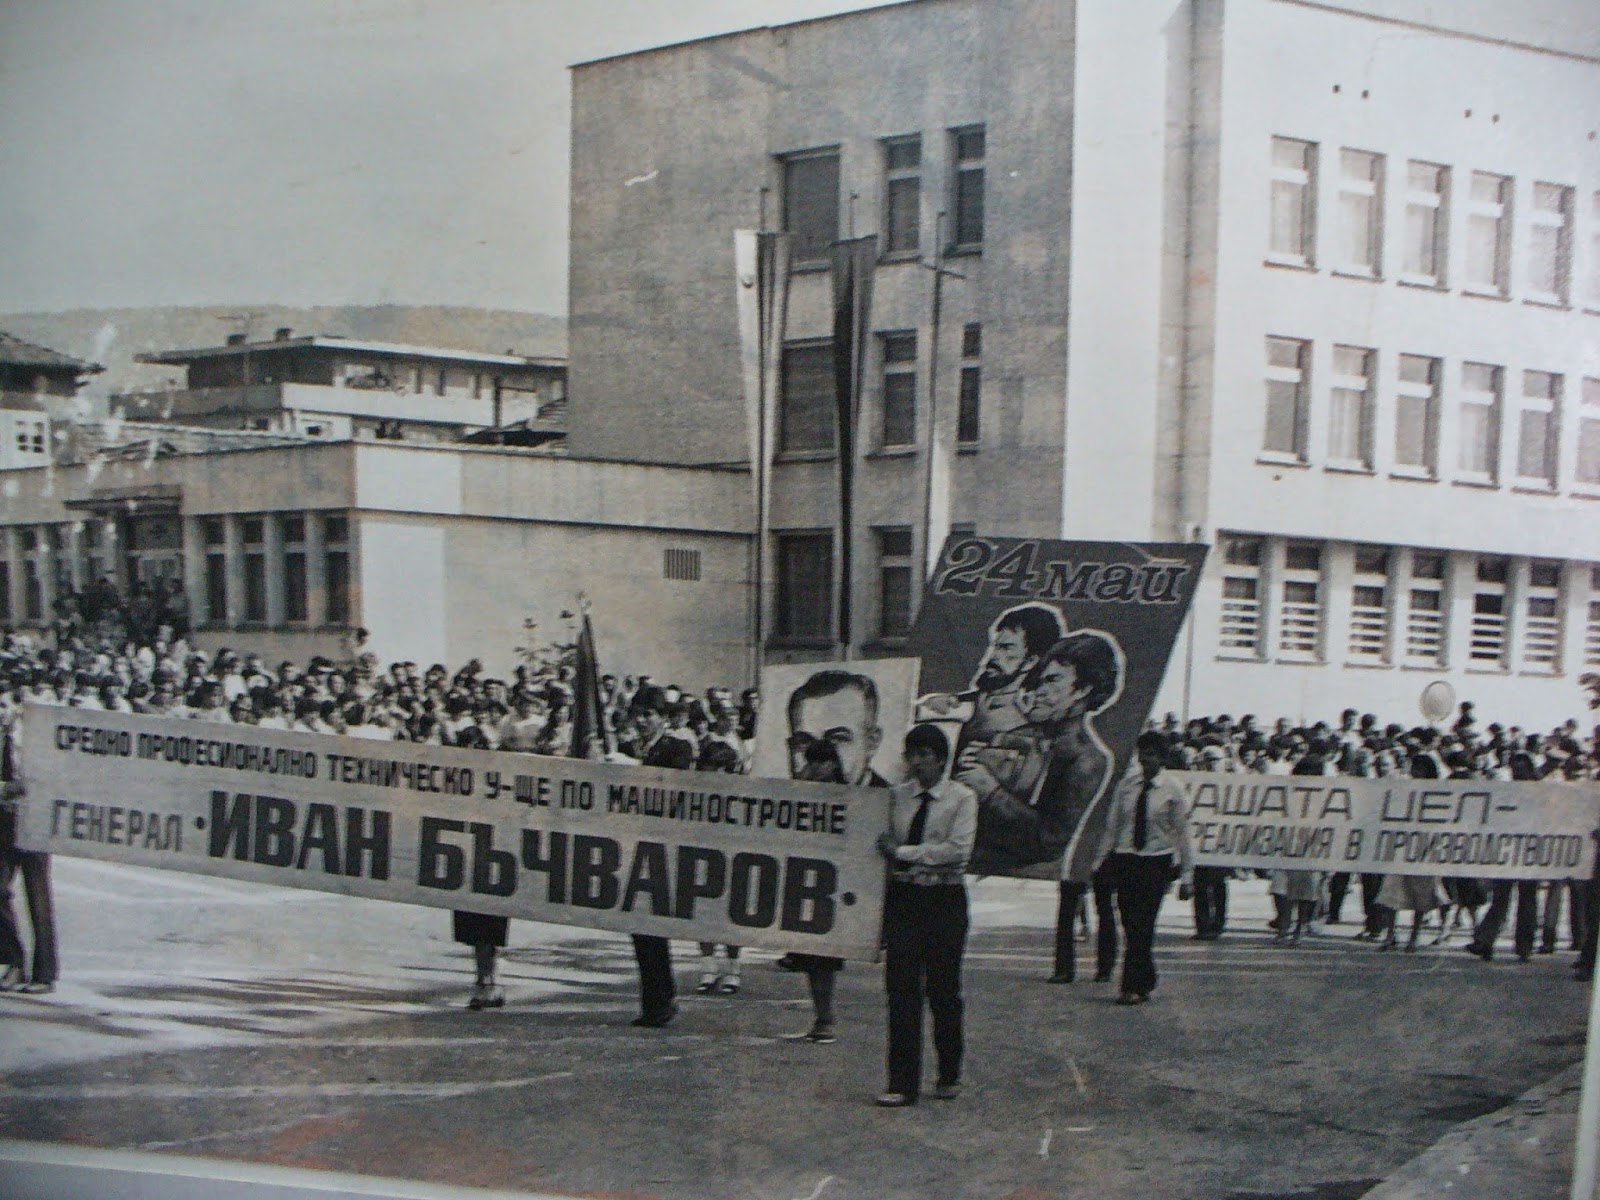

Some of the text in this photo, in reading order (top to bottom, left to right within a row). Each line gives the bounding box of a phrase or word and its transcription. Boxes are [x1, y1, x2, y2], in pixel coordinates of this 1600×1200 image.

[935, 538, 1040, 599] 24
[56, 724, 847, 834] СРЕДНО ПРОФЕСИОНАЛНО ТЕХНИЧЕСКО У-ЩЕ ПО МАШИНОСТРОЕНЕ
[1185, 783, 1352, 821] АШАТА
[51, 790, 837, 935] ГЕНЕРАЛ ИВАН БЪЧВАРОВ
[1344, 828, 1364, 861] В
[1372, 830, 1583, 867] ПРОИЗВОДСТВОТО
